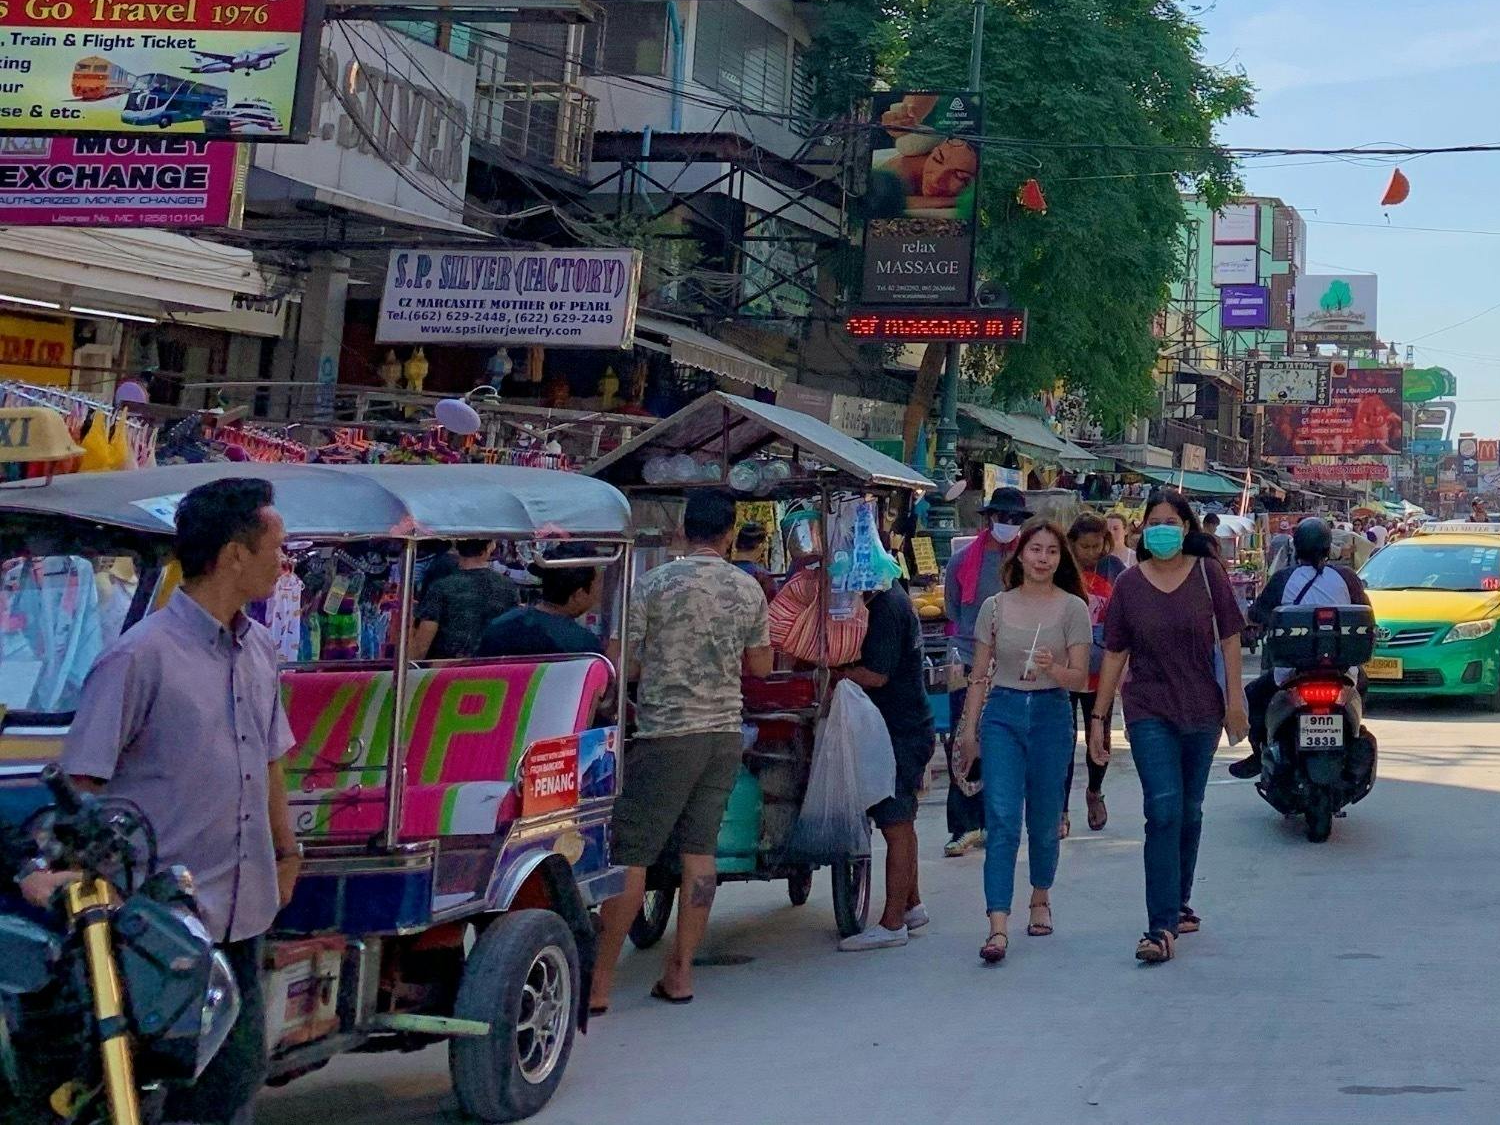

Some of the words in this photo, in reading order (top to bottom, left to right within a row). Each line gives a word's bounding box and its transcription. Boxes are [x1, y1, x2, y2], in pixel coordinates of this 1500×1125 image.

[211, 5, 269, 25] 1976
[10, 33, 57, 47] Train
[63, 34, 76, 47] &
[82, 33, 135, 50] Flight
[141, 35, 197, 50] Ticket
[29, 106, 43, 119] &
[49, 106, 86, 120] etc.
[73, 137, 211, 156] MONEY
[0, 164, 211, 191] EXCHANGE
[0, 195, 81, 206] AUTHORIZED
[85, 196, 136, 206] MONEY
[139, 195, 205, 206] CHANGER
[115, 214, 134, 223] MC
[901, 239, 937, 254] relax
[395, 253, 432, 289] S.P.
[439, 255, 514, 291] SILVER
[514, 257, 626, 298] (FACTORY)
[875, 260, 960, 276] MASSAGE
[398, 297, 413, 308] CZ
[416, 298, 487, 310] MARCASITE
[491, 300, 545, 311] MOTHER
[550, 301, 567, 311] OF
[570, 301, 613, 312] PEARL
[386, 310, 442, 323] Tel.(662)
[514, 312, 548, 324] (622)
[553, 313, 614, 325] 629-2449
[420, 325, 582, 337] www.spsilverjewelry.com
[1310, 716, 1334, 726] 9กก
[1306, 736, 1337, 746] 3838
[534, 772, 575, 798] PENANG
